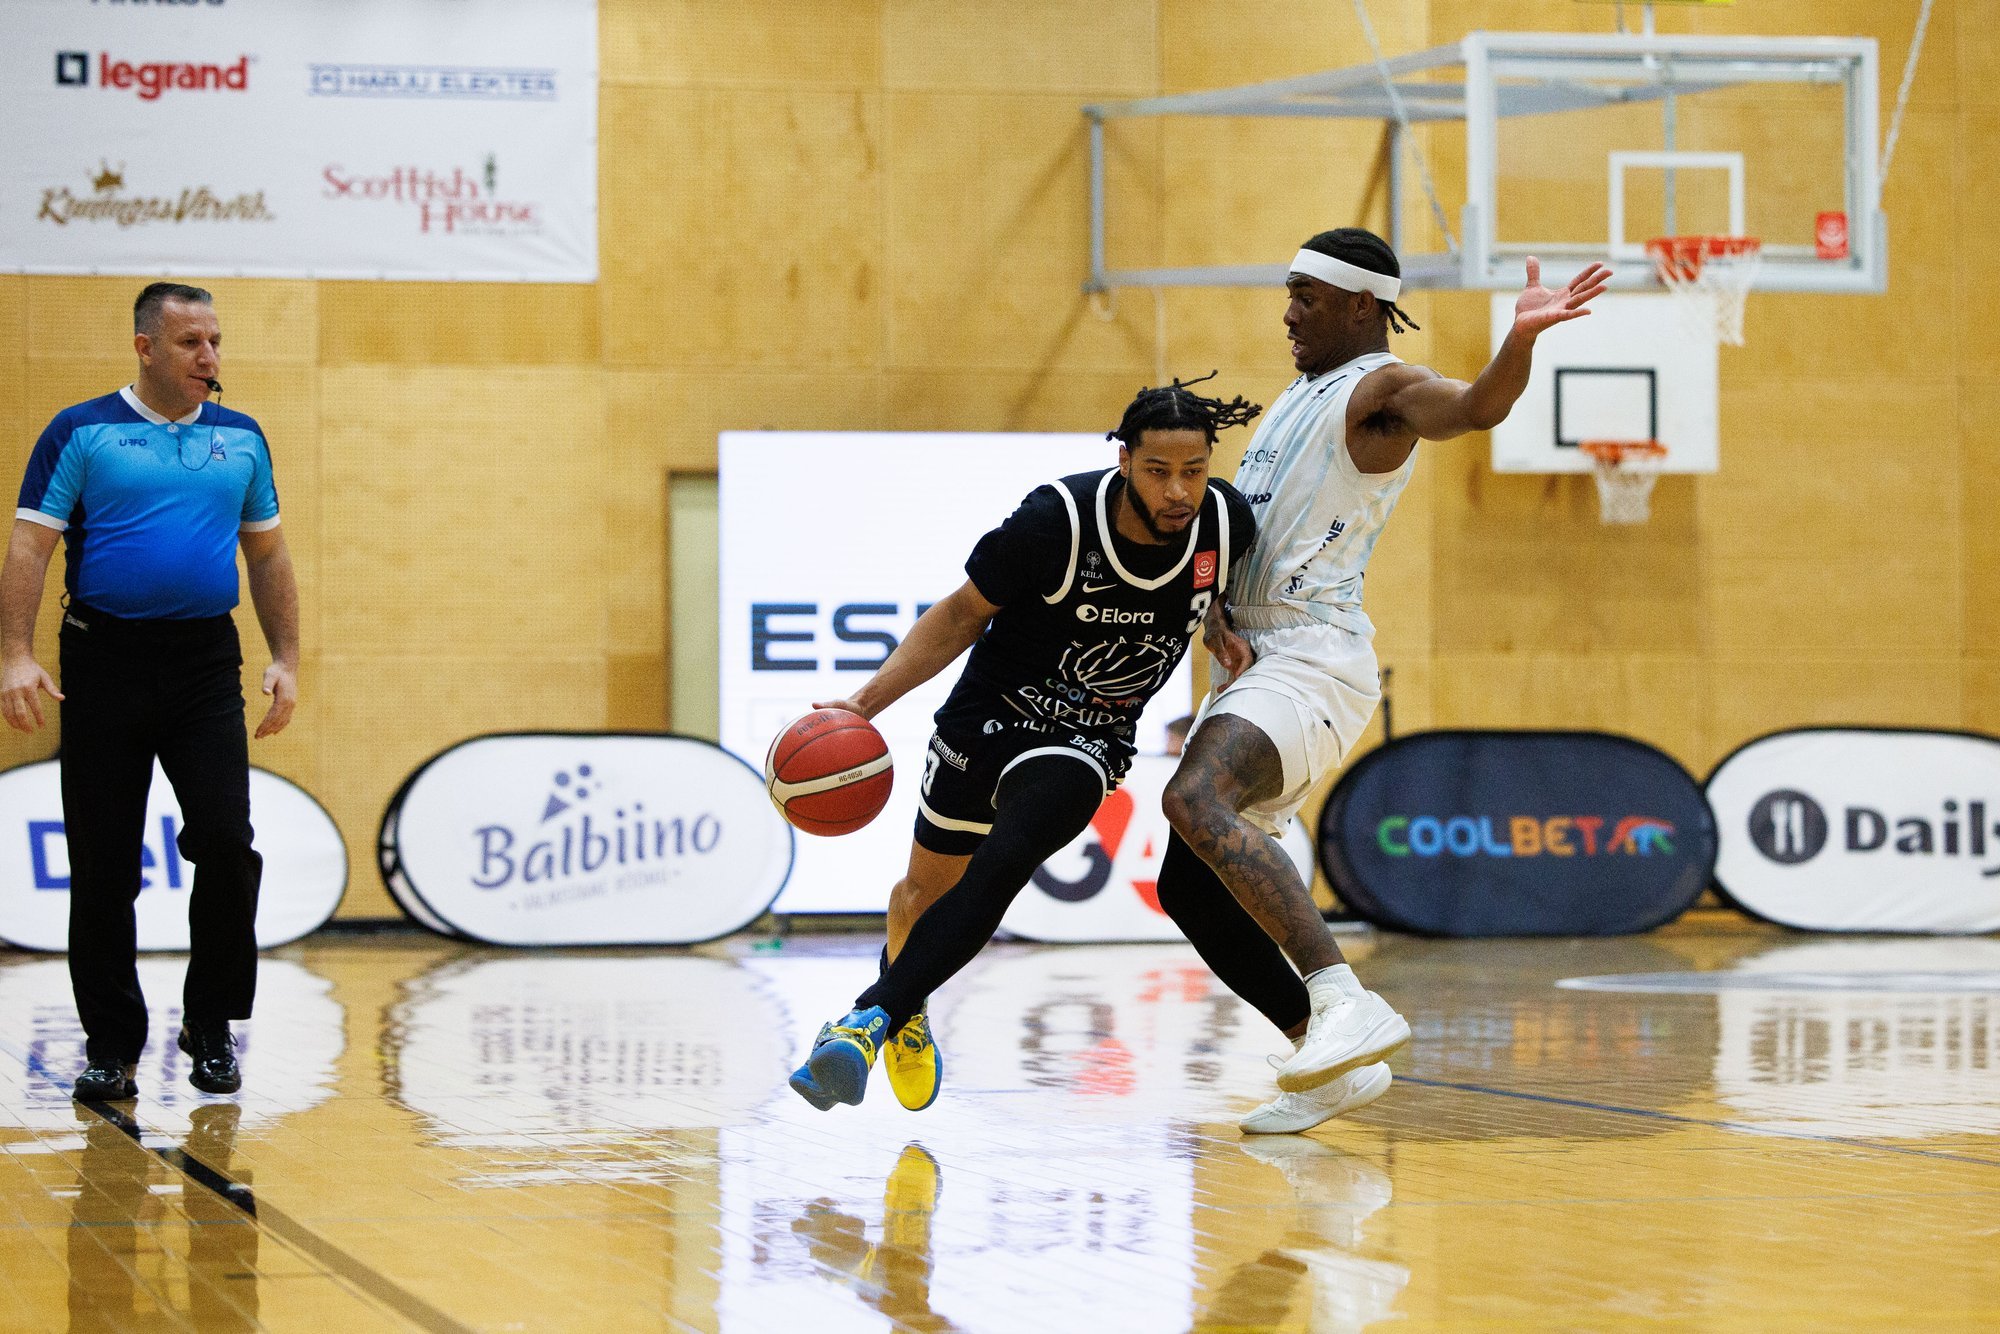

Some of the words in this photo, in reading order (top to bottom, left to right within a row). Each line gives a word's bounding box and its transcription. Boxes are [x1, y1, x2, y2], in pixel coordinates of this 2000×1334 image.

[100, 51, 247, 101] legrand
[322, 163, 479, 201] Scottish
[1080, 569, 1104, 580] KEILA
[1100, 607, 1155, 625] Elora
[1185, 589, 1213, 635] 3
[470, 803, 722, 890] Balbiino
[1375, 815, 1604, 858] COOLBET
